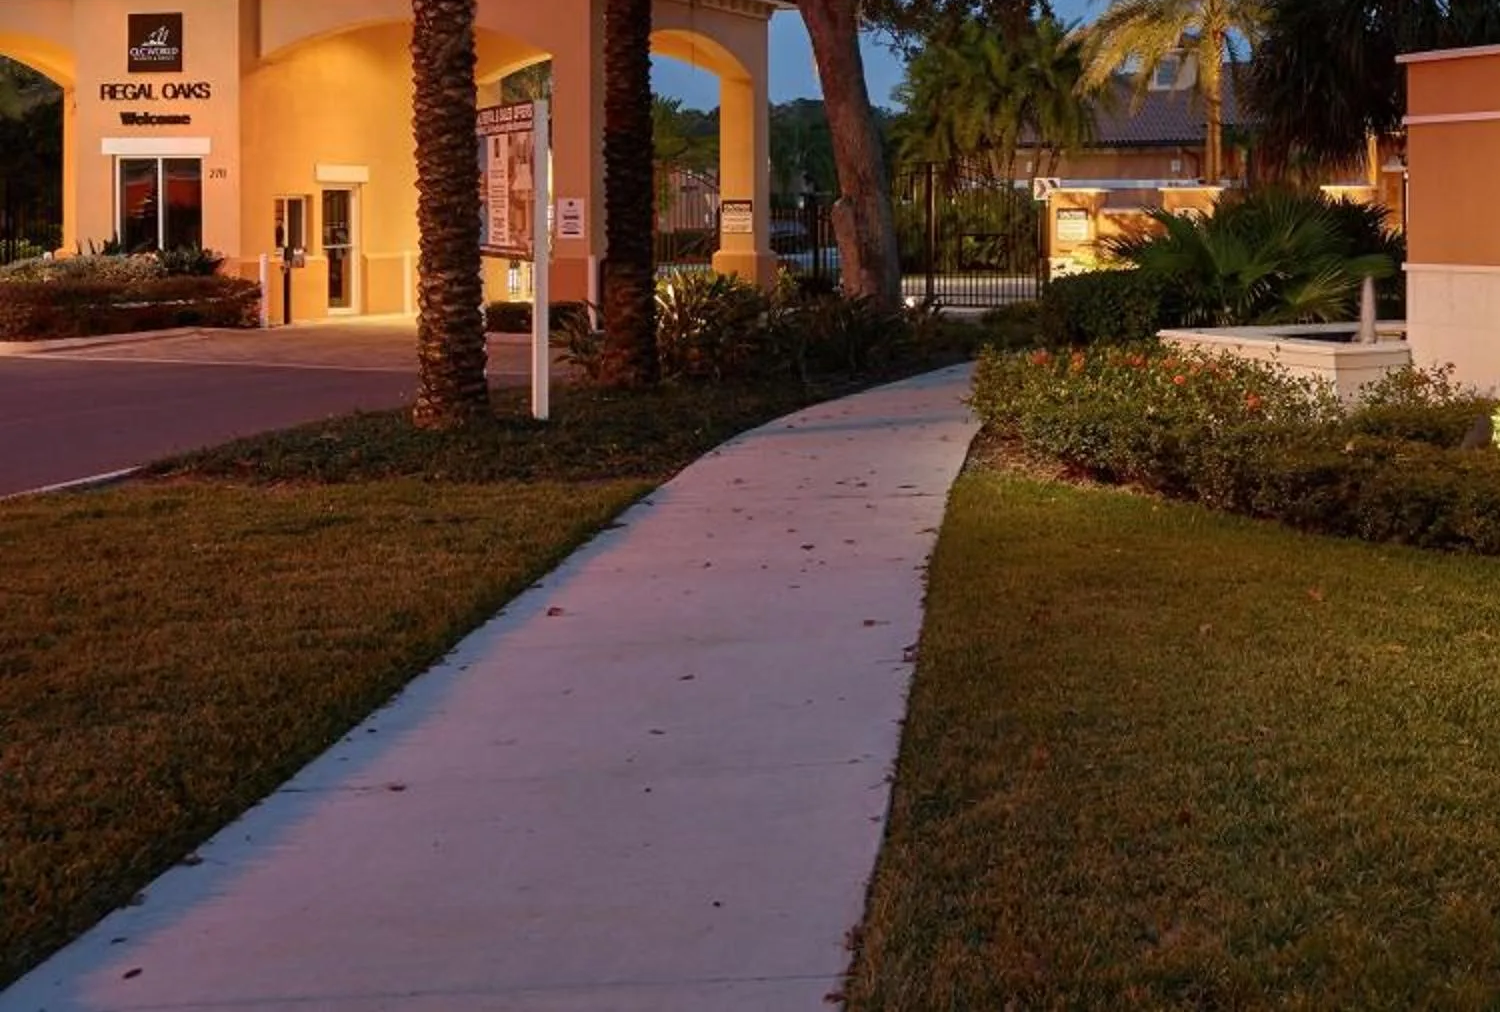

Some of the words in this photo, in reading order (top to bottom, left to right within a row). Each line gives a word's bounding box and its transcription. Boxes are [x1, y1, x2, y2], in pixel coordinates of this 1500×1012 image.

[100, 82, 158, 101] REGAL
[161, 81, 212, 100] OAKS
[119, 112, 192, 126] Welcome
